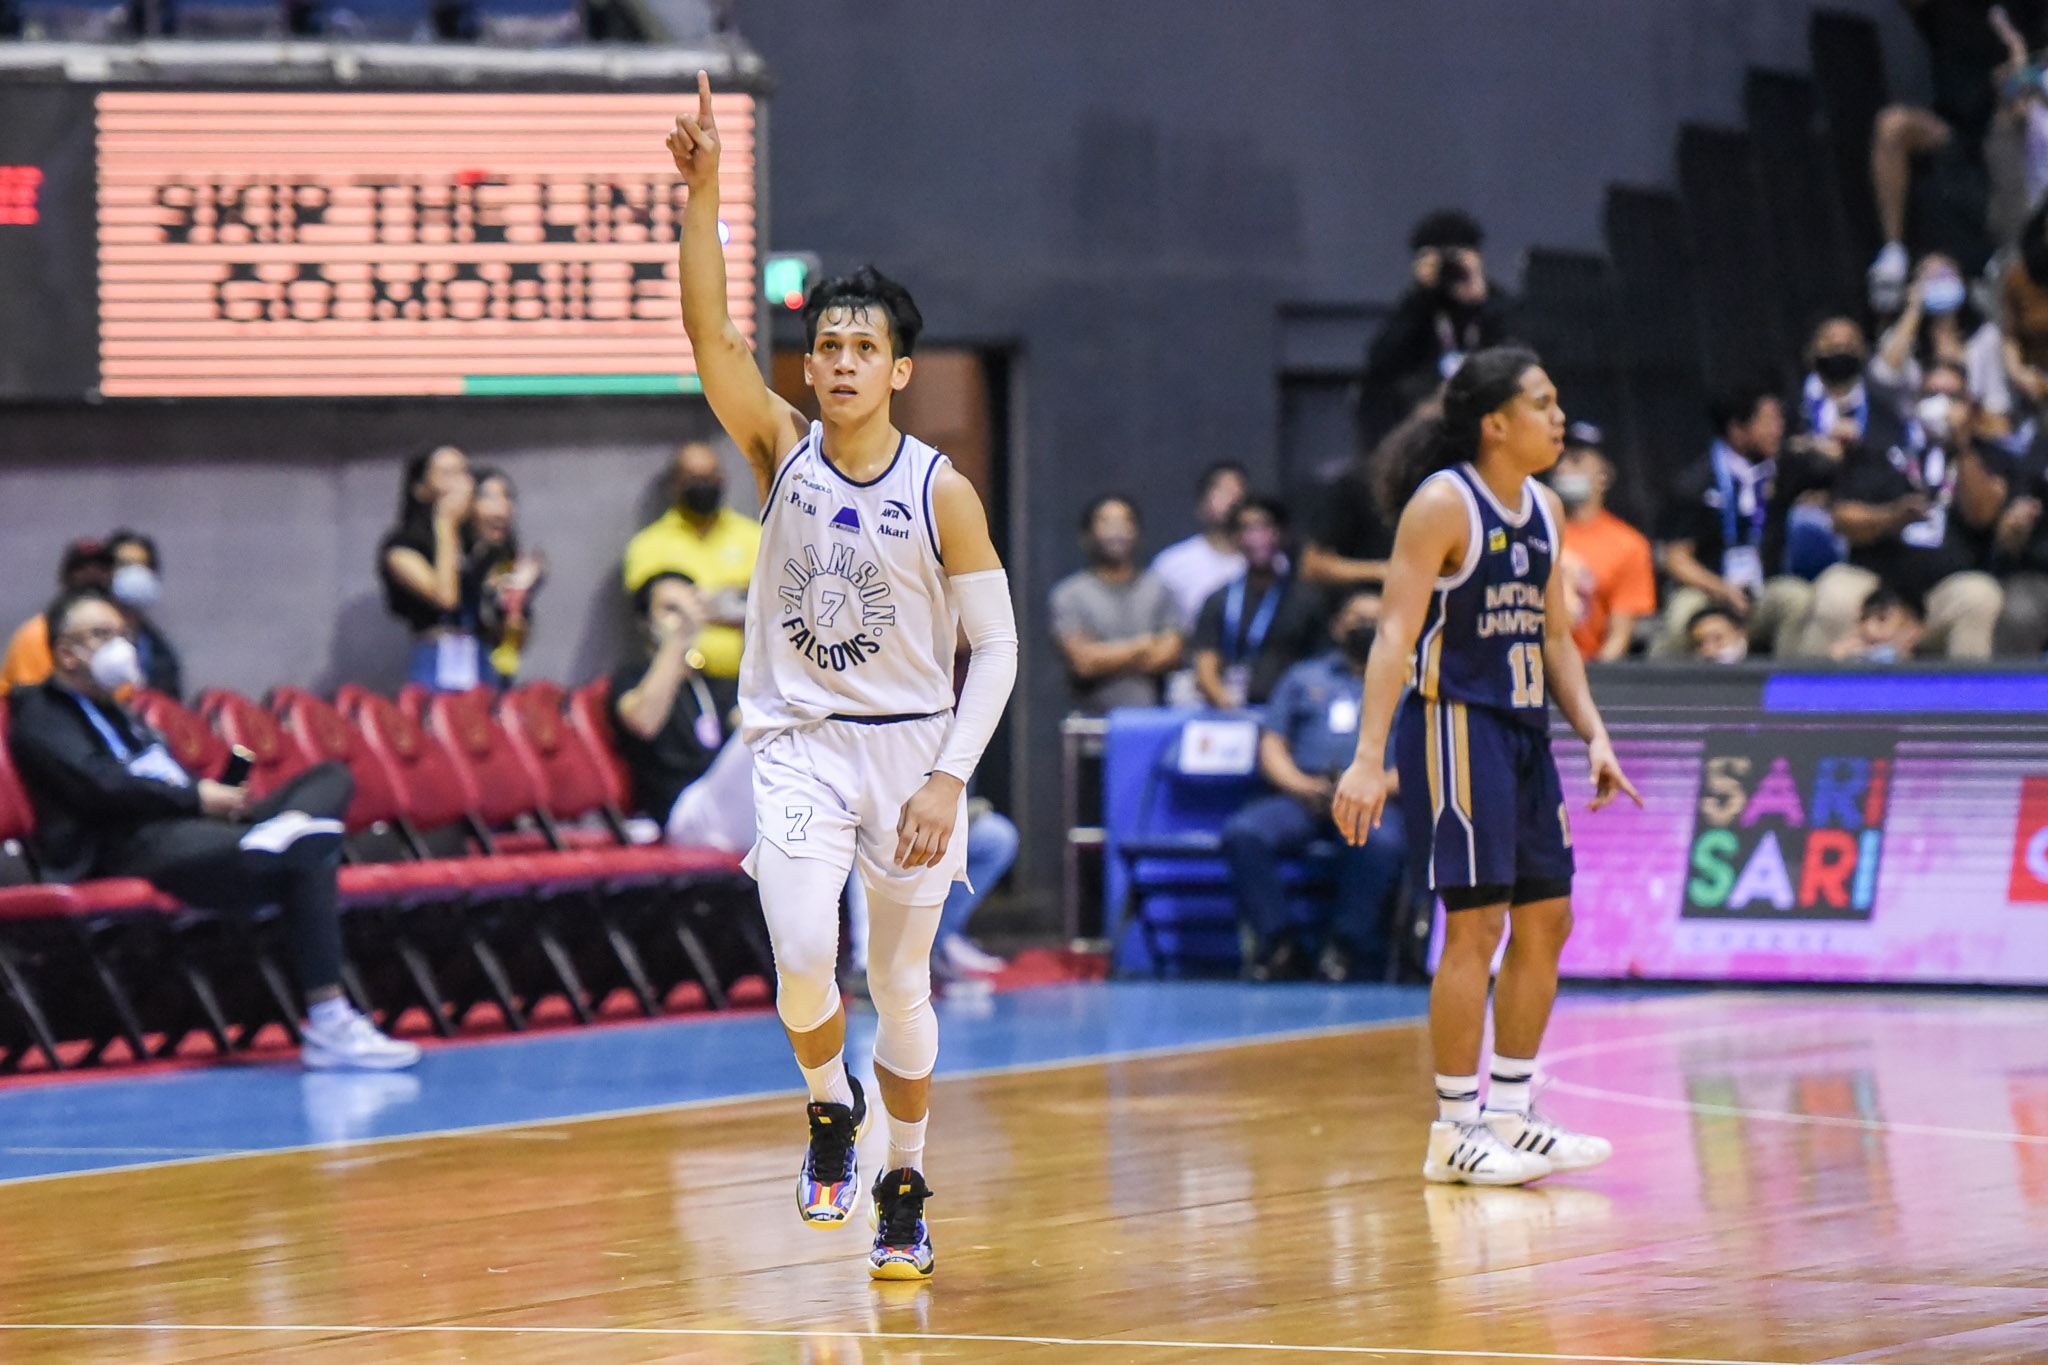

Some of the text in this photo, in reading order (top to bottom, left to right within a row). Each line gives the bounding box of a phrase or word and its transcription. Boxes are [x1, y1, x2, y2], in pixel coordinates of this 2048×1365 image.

[155, 174, 331, 243] SKIP
[353, 174, 509, 243] THE
[211, 262, 676, 322] GO MOBILE
[877, 524, 909, 540] Akari
[778, 542, 895, 627] ADAMSON
[817, 590, 846, 628] 7
[782, 616, 880, 672] FALCONS
[1700, 756, 1889, 828] SARI
[786, 806, 813, 841] 7
[1688, 829, 1881, 911] SARI
